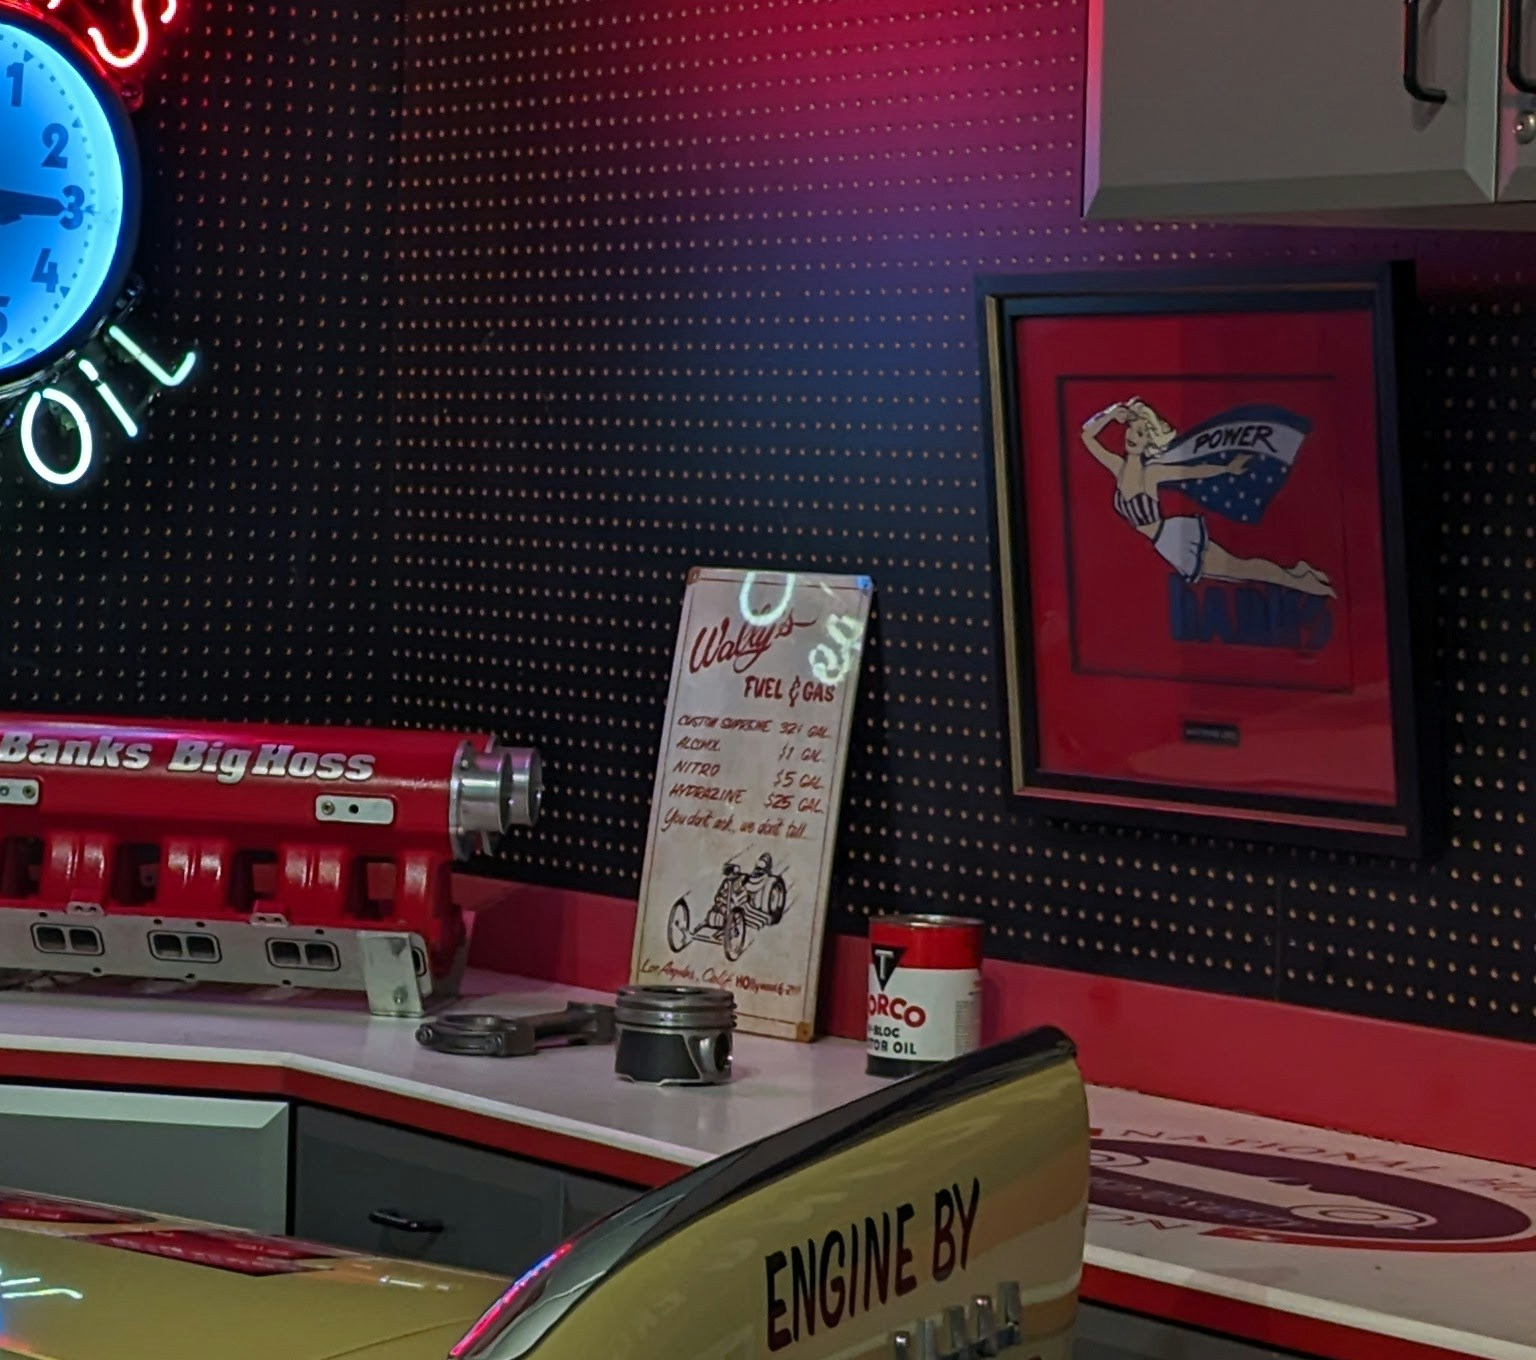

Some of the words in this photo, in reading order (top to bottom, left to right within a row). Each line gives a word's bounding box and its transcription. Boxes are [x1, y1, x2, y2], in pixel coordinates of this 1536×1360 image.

[6, 62, 24, 107] 1
[41, 122, 69, 169] 2
[58, 184, 85, 230] 3
[31, 248, 58, 293] 4
[20, 324, 196, 485] OIL
[1192, 425, 1278, 454] POWER
[743, 675, 783, 699] FUEL
[802, 685, 837, 702] GAS
[672, 760, 720, 777] NITRO
[773, 769, 797, 787] $5
[668, 783, 747, 804] HYDRAZINE
[764, 792, 794, 810] $25
[875, 949, 894, 980] T
[893, 1041, 917, 1055] OIL
[1122, 1128, 1441, 1173] NATIONAL
[765, 1202, 918, 1353] ENGINE
[931, 1177, 981, 1282] BY
